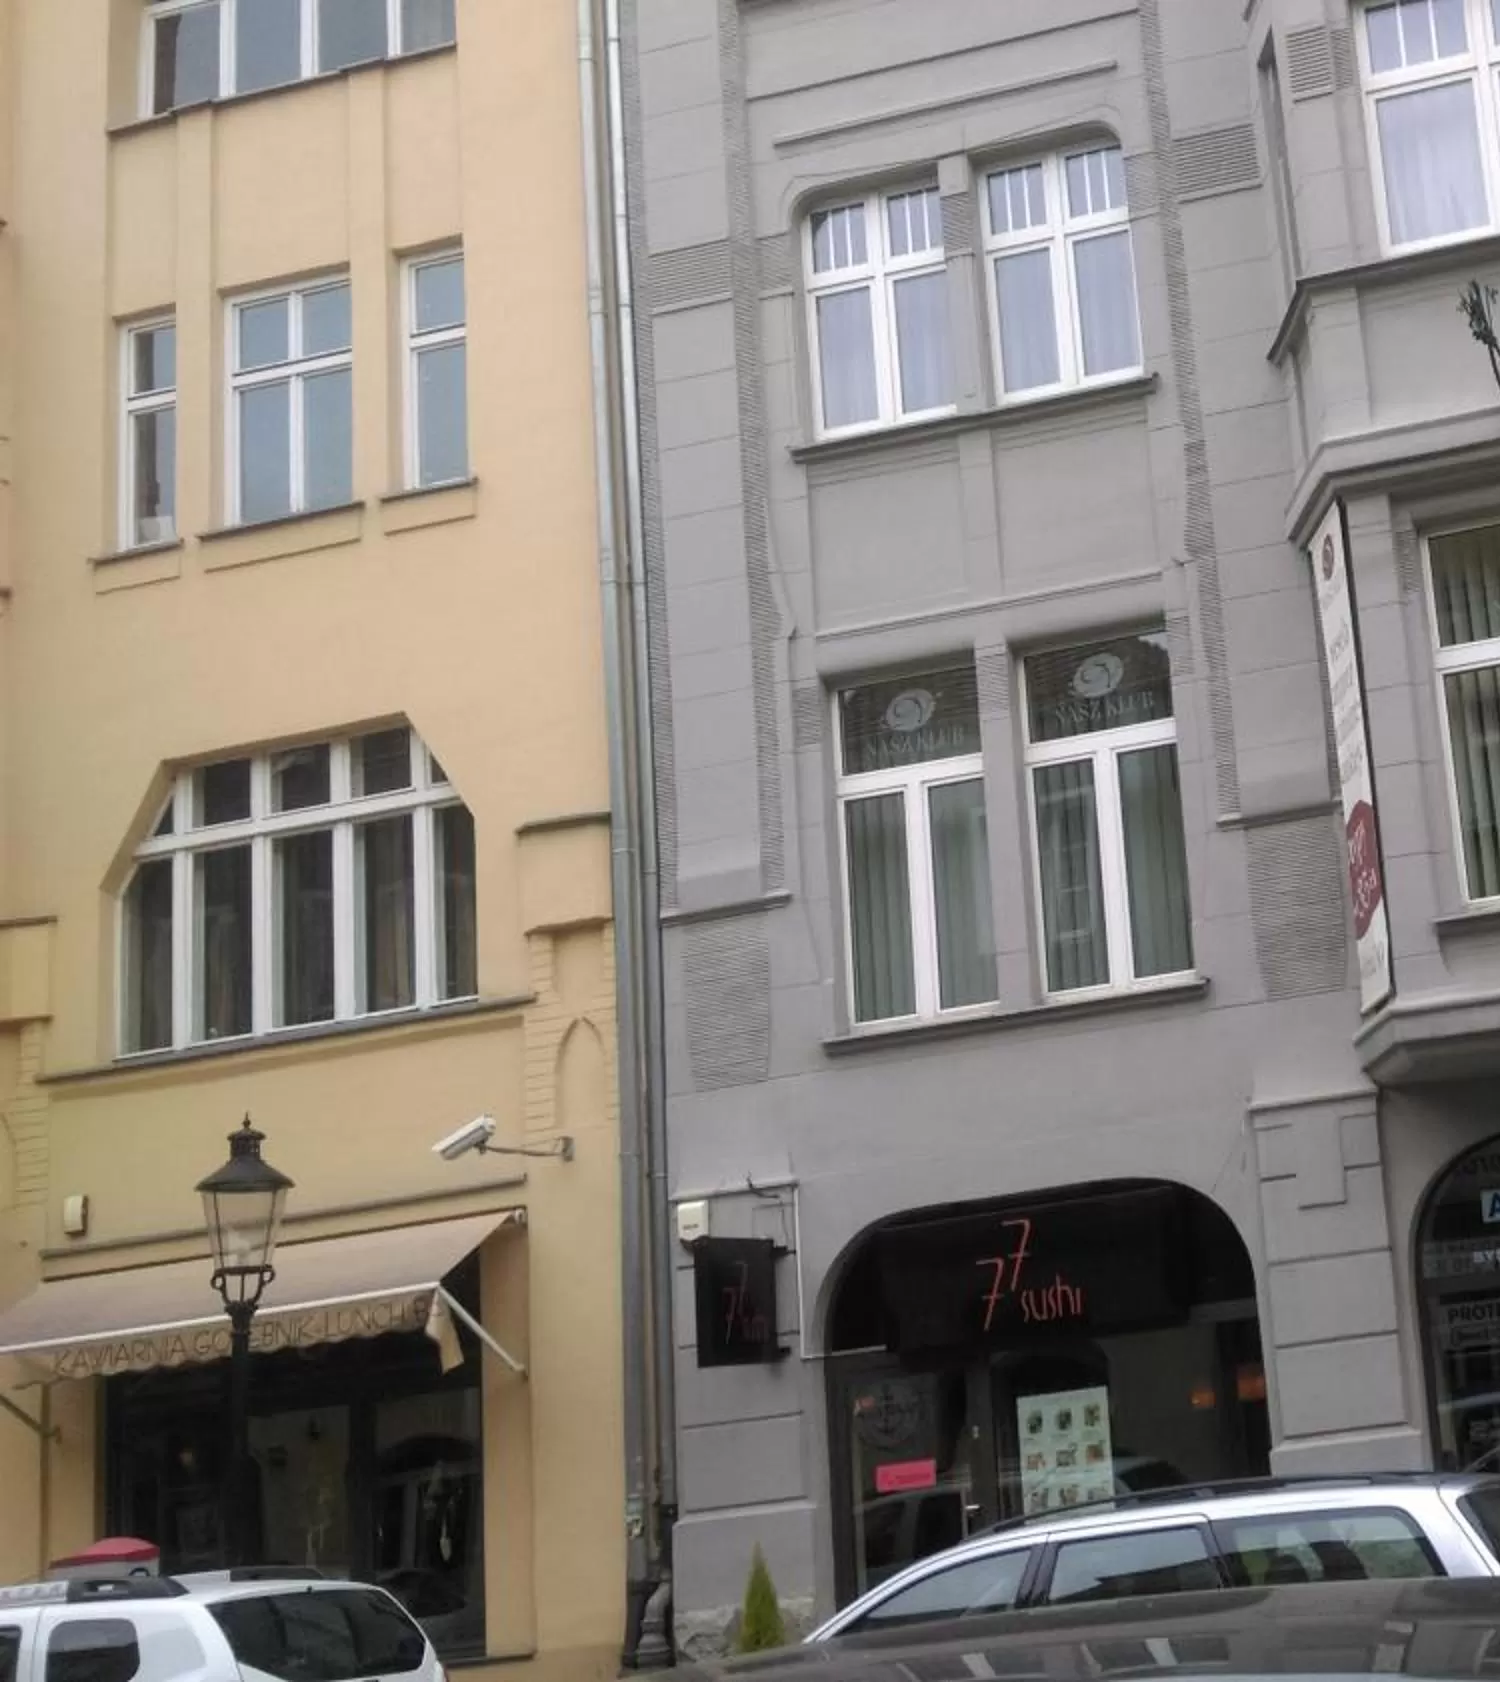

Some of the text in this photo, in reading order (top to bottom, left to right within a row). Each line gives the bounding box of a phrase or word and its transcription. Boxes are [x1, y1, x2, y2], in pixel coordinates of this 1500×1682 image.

[1021, 1273, 1081, 1323] sushi
[54, 1334, 186, 1375] KAWIARNIA
[324, 1300, 406, 1336] LUNCH
